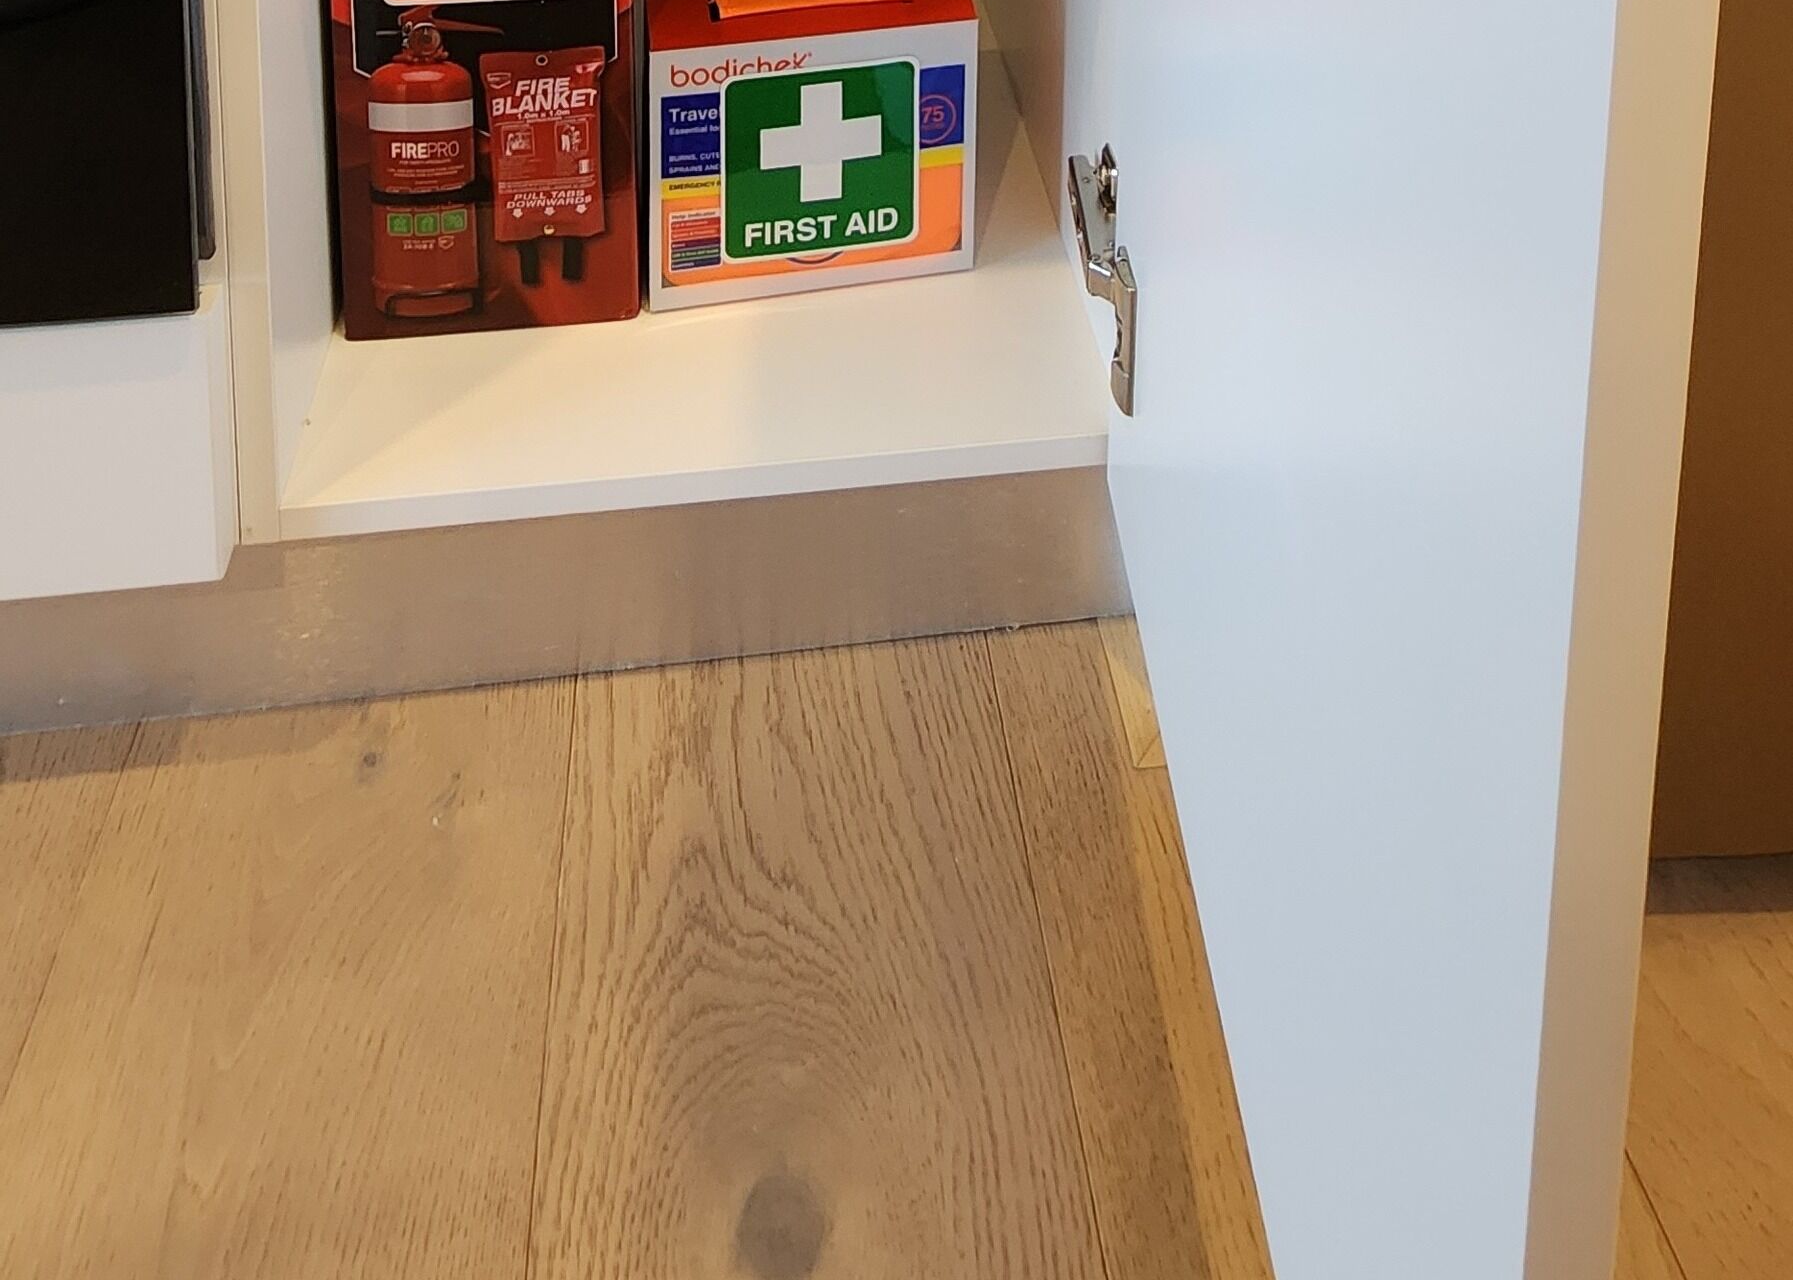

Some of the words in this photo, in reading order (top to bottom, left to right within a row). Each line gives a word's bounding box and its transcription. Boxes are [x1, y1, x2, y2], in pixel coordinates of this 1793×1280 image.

[515, 77, 571, 96] FIRE
[492, 88, 598, 117] BLANKET
[669, 108, 720, 123] Trave
[921, 105, 945, 124] 75
[391, 141, 460, 159] FIREPRO
[506, 195, 593, 209] DOWNWARDS
[514, 191, 547, 201] PULL
[551, 189, 585, 199] TABS
[745, 214, 838, 248] FIRST
[845, 207, 899, 237] AID
